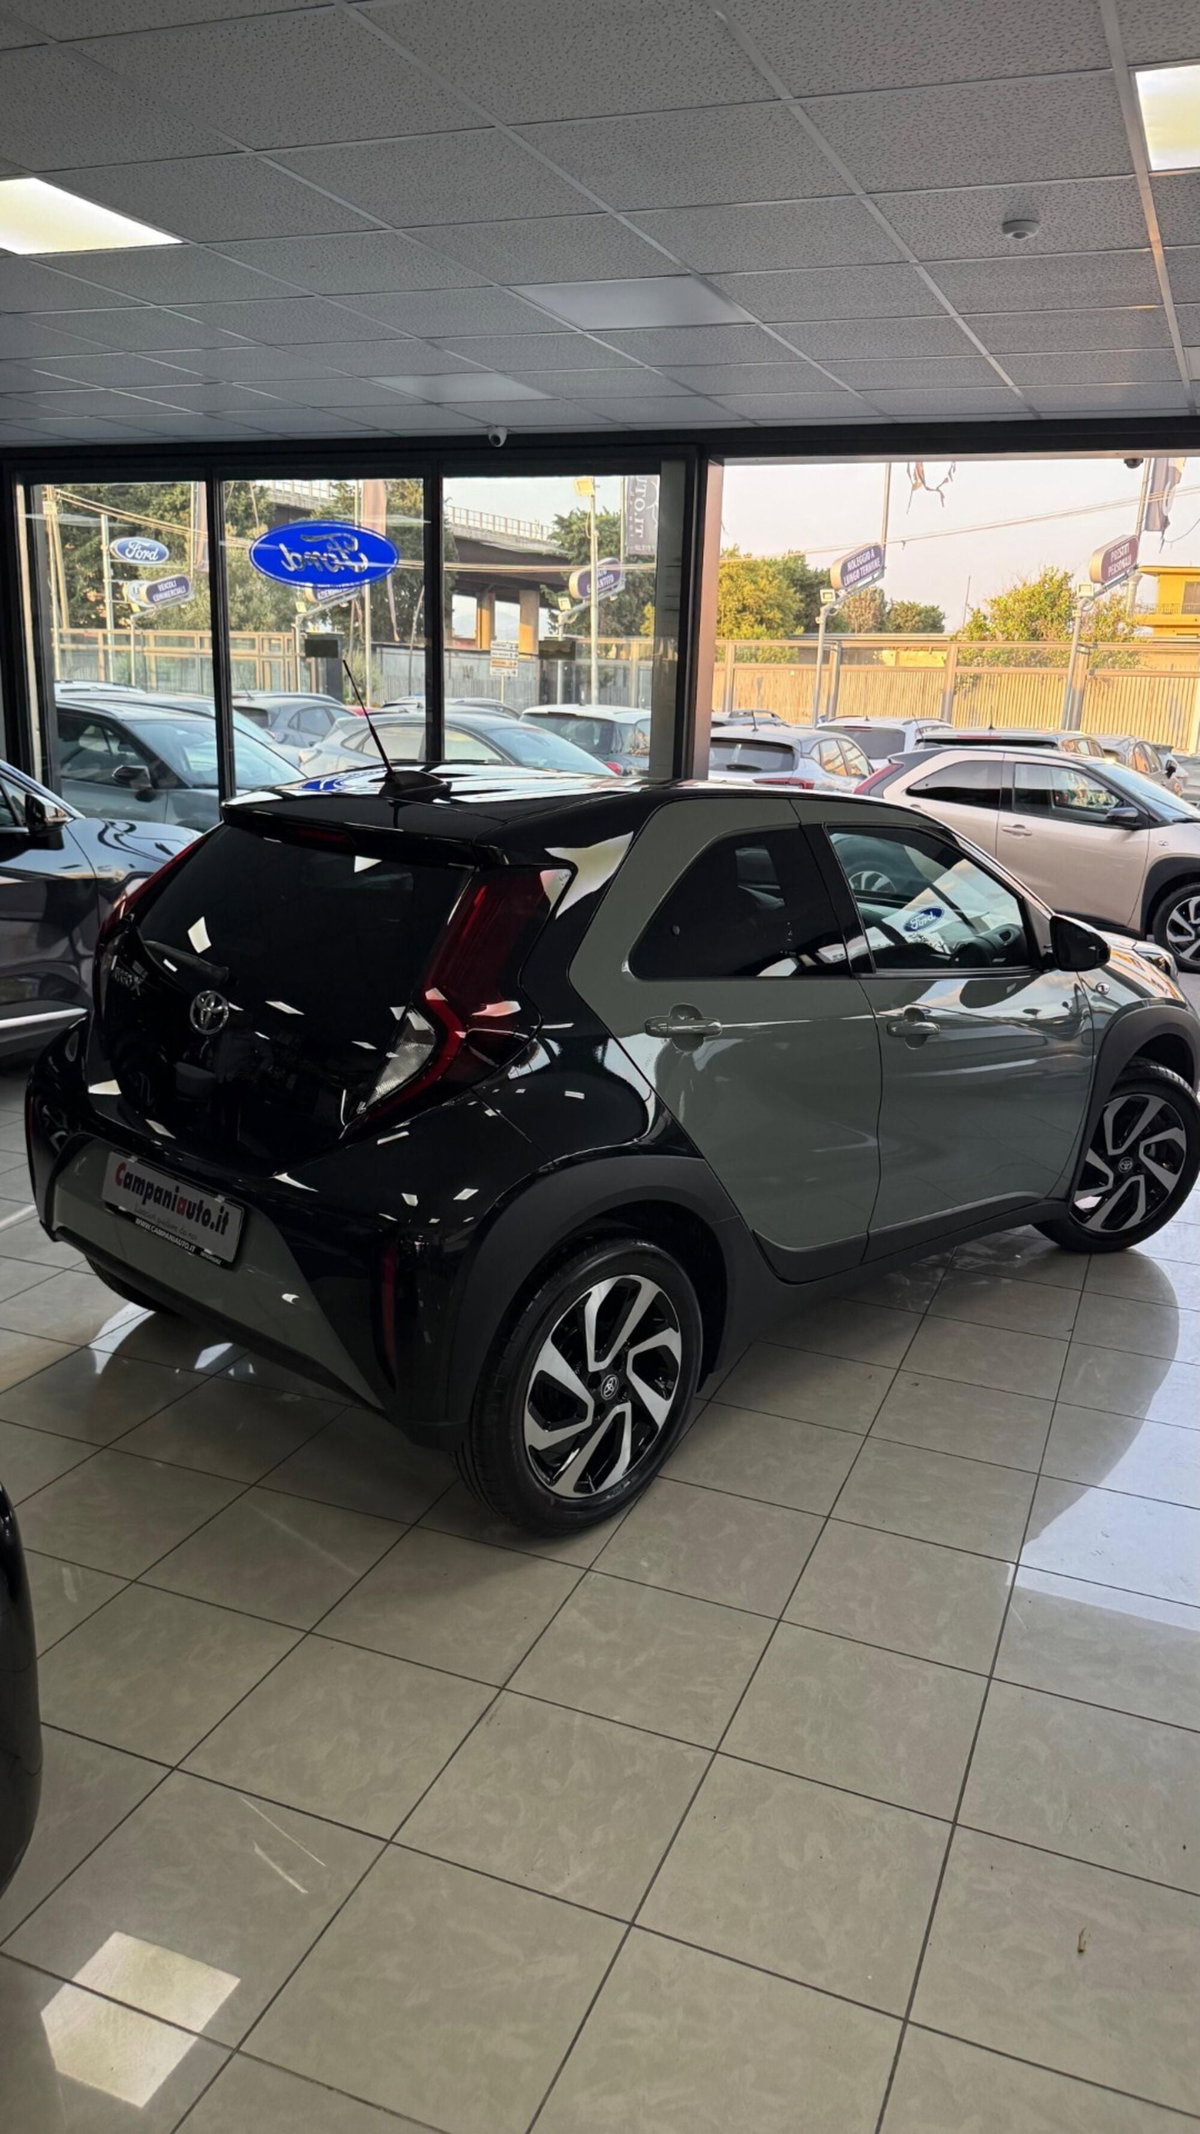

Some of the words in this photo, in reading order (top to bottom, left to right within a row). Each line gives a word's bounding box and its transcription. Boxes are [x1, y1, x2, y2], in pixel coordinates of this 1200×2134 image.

[125, 540, 159, 561] Ford
[910, 911, 937, 930] Ford
[115, 1162, 230, 1236] Campaniauto.it
